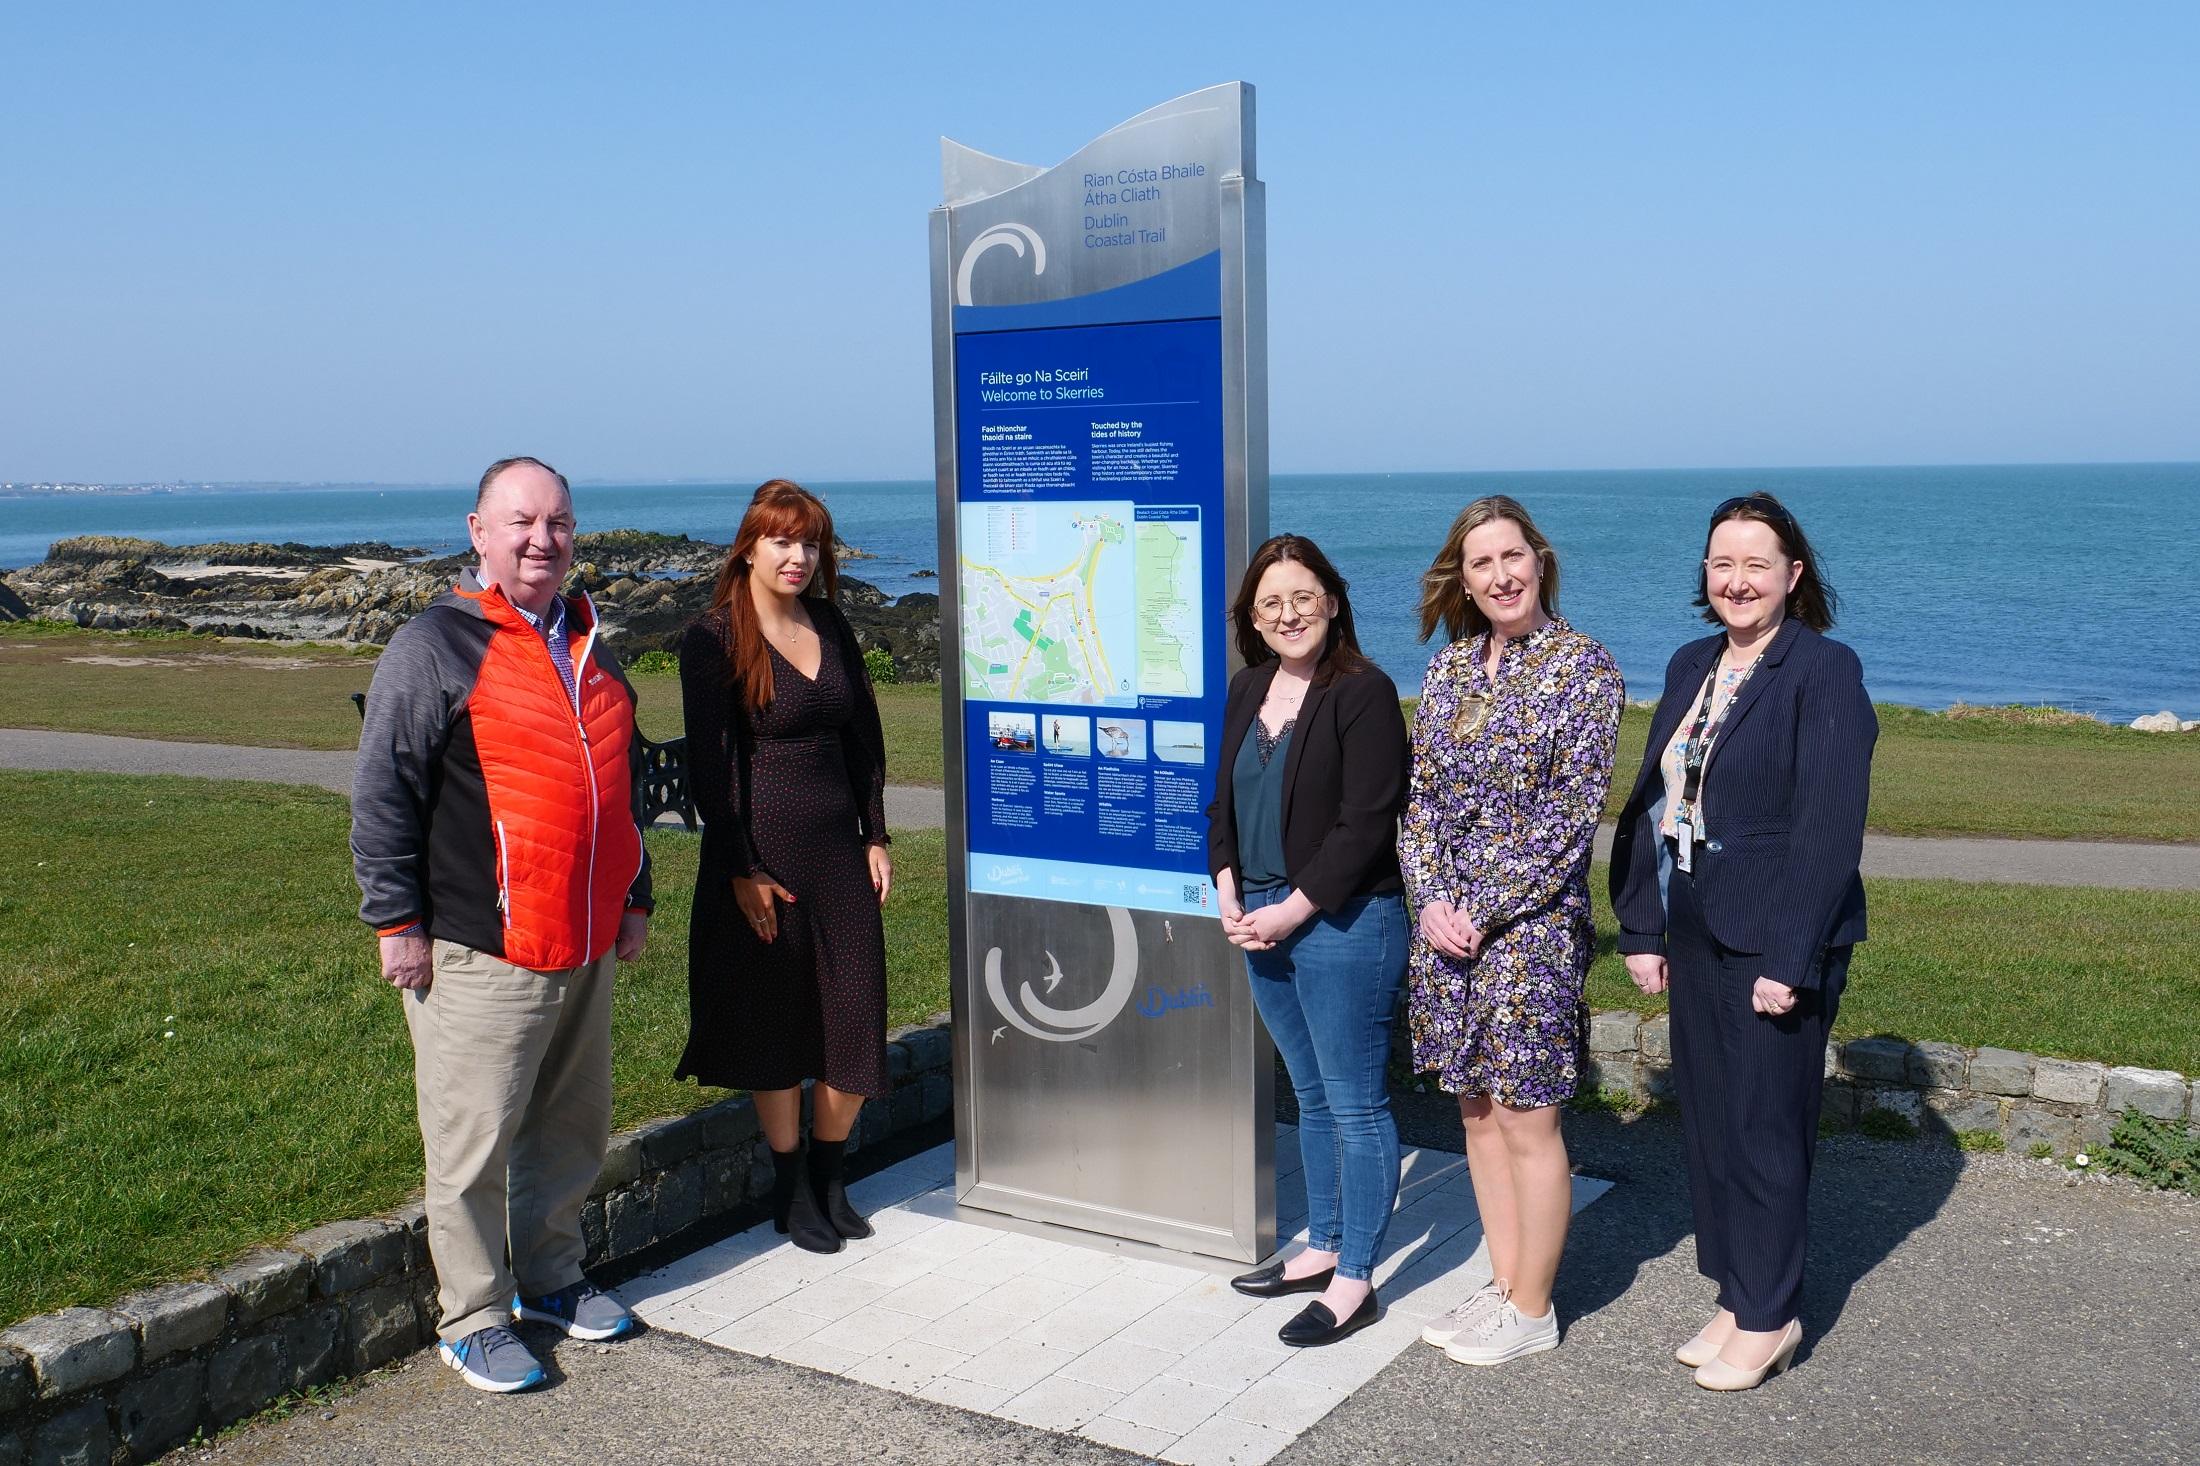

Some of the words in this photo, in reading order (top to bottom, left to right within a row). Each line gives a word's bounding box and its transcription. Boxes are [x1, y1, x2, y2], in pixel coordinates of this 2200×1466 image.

[1084, 172, 1113, 188] Rian
[1118, 168, 1157, 185] Cósta
[1162, 162, 1205, 180] Bhaile
[1084, 189, 1117, 206] Átha
[1121, 186, 1160, 203] Cliath
[1084, 214, 1128, 230] Dublin
[1084, 229, 1136, 248] Coastal
[1138, 227, 1165, 244] Trail
[981, 371, 1013, 385] Fáilte
[1016, 373, 1032, 386] go
[1035, 370, 1052, 382] Na
[1055, 368, 1088, 381] Sceirí
[982, 389, 1036, 402] Welcome
[1040, 389, 1052, 400] to
[1055, 387, 1104, 399] Skerries
[996, 424, 1027, 433] thionchar
[1091, 421, 1118, 430] Touched
[1120, 421, 1129, 430] by
[1091, 430, 1108, 438] tides
[1118, 429, 1141, 439] history
[1136, 982, 1214, 1019] Dublin
